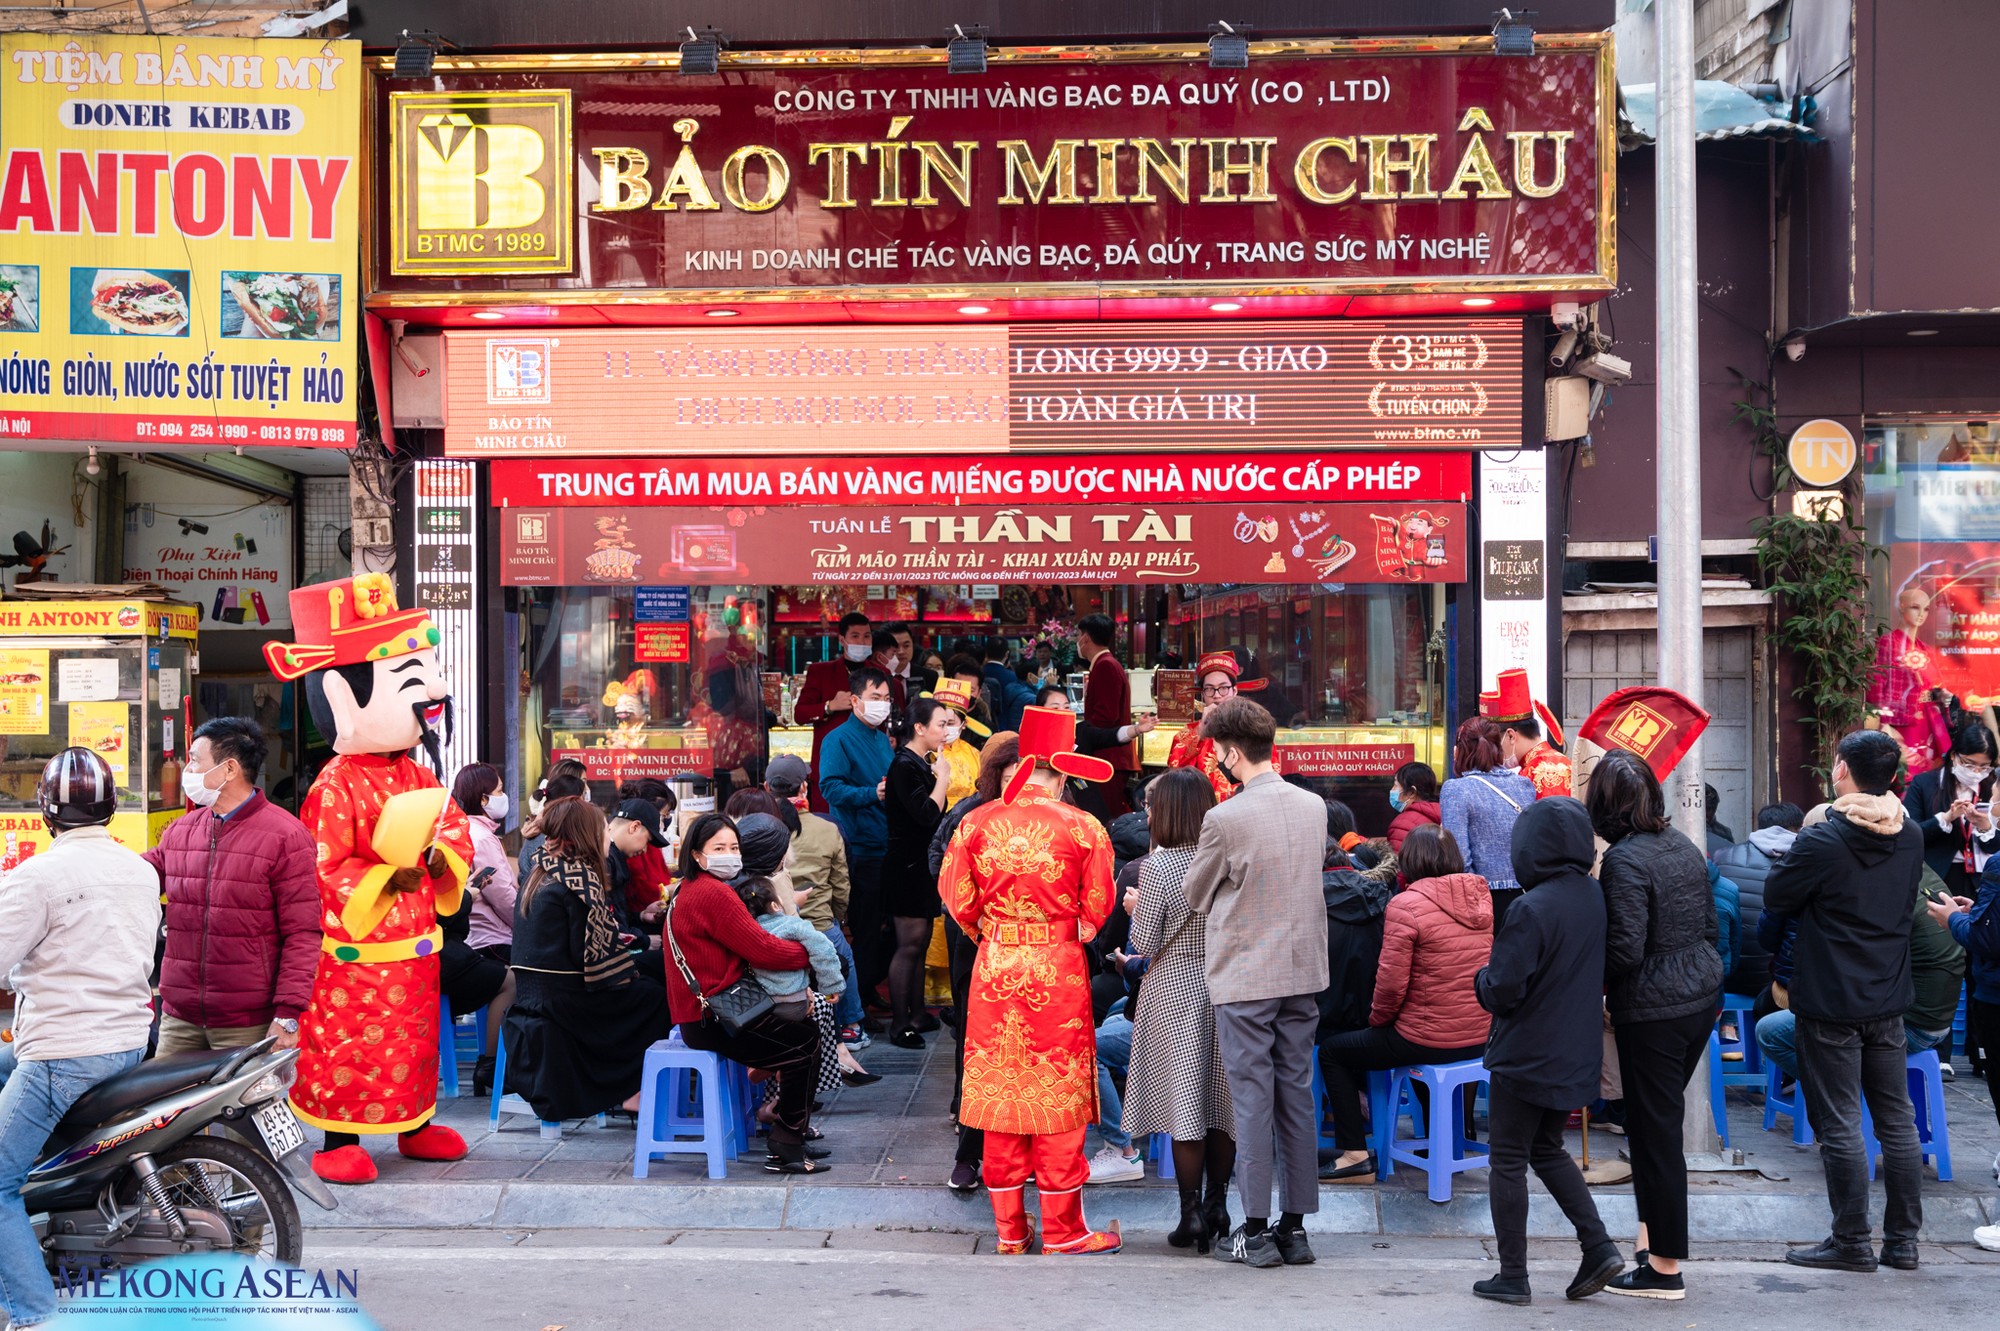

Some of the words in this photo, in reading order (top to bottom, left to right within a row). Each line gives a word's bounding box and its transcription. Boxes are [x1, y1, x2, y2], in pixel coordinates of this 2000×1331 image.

[13, 41, 123, 92] TIỆM
[135, 44, 264, 88] BÁNH
[773, 85, 855, 112] CÔNG
[860, 89, 897, 110] TY
[906, 87, 980, 110] TNHH
[985, 78, 1058, 109] VÀNG
[1064, 83, 1123, 111] BẠC
[1130, 82, 1173, 107] ĐA
[1179, 76, 1238, 107] QUÝ
[73, 103, 171, 127] DONER
[189, 106, 290, 130] KEBAB
[592, 118, 790, 213] BẢO
[808, 115, 979, 209] TÍN
[997, 137, 1278, 206] MINH
[1293, 106, 1574, 205] CHÂU
[0, 151, 348, 239] ANTONY
[417, 234, 485, 253] BTMC
[494, 233, 545, 252] 1989
[685, 250, 743, 271] KINH
[751, 249, 840, 270] DOANH
[846, 240, 899, 270] CHẾ
[907, 240, 956, 269] TÁC
[964, 238, 1031, 267] VÀNG
[1217, 241, 1305, 263] TRANG
[1315, 234, 1367, 262] SỨC
[1376, 235, 1414, 261] MỸ
[1420, 232, 1491, 266] NGHỆ
[1433, 335, 1466, 343] BTMC
[654, 342, 757, 377] VÀNG
[880, 341, 1005, 375] THĂNG
[1015, 347, 1117, 374] LONG
[1124, 346, 1209, 372] 999.9
[1238, 345, 1328, 372] GIAO
[64, 351, 117, 401] GIÒN,
[125, 357, 179, 398] NƯỚC
[187, 352, 225, 399] SỐT
[230, 359, 290, 409] TUYỆT
[304, 352, 344, 404] HẢO
[674, 397, 765, 429] DỊCH
[771, 397, 843, 428] MỌI
[932, 389, 1009, 423] BẢO
[1019, 387, 1117, 422] TOÀN
[1128, 388, 1189, 421] GIÁ
[1200, 393, 1257, 425] TRỊ
[1386, 393, 1429, 415] TUYỂN
[1432, 399, 1470, 417] CHỌN
[12, 417, 31, 436] NỘI
[488, 414, 522, 430] BẢO
[525, 413, 552, 430] TÍN
[137, 422, 156, 436] ĐT:
[159, 423, 183, 437] 094
[190, 424, 214, 438] 254
[218, 424, 247, 439] 1990
[260, 426, 291, 440] 0813
[295, 426, 318, 441] 979
[321, 427, 345, 442] 898
[475, 436, 517, 449] MINH
[521, 432, 567, 448] CHÂU
[1374, 427, 1481, 440] www.btmc.vn
[1797, 438, 1847, 468] TN
[538, 472, 633, 498] TRUNG
[639, 466, 700, 497] TÂM
[707, 471, 775, 497] MUA
[781, 465, 839, 496] BÁN
[844, 466, 923, 495] VÀNG
[931, 463, 1024, 494] MIẾNG
[1029, 468, 1115, 498] ĐƯỢC
[1122, 463, 1185, 493] NHÀ
[1193, 463, 1275, 493] NƯỚC
[1282, 458, 1340, 492] CẤP
[1347, 463, 1421, 491] PHÉP
[809, 517, 864, 533] TUẦN
[870, 516, 891, 533] LỄ
[899, 509, 1072, 543] THẦN
[1092, 509, 1193, 542] TÀI
[157, 547, 195, 563] Phụ
[200, 547, 242, 563] Kiện
[533, 556, 556, 564] CHÂU
[813, 549, 851, 568] KIM
[857, 550, 897, 568] MÃO
[903, 547, 950, 567] THẦN
[956, 550, 984, 567] TÀI
[1002, 553, 1047, 567] KHAI
[1052, 549, 1102, 567] XUÂN
[1108, 553, 1139, 570] ĐẠI
[1144, 549, 1196, 569] PHÁT
[156, 568, 193, 583] Thoại
[198, 567, 238, 581] Chính
[242, 567, 278, 583] Hãng
[825, 571, 850, 580] NGÀY
[1032, 571, 1080, 580] 10/01/2023
[27, 612, 113, 626] ANTONY
[176, 613, 197, 631] KEBAB
[1614, 731, 1629, 743] BTMC
[588, 753, 612, 765] BẢO
[637, 755, 668, 764] MINH
[671, 753, 704, 764] CHÂU
[1287, 750, 1311, 760] BẢO
[1315, 749, 1334, 760] TÍN
[1337, 750, 1369, 760] MINH
[1372, 748, 1405, 760] CHÂU
[647, 768, 669, 776] NHÂN
[1298, 763, 1318, 772] KÍNH
[1320, 763, 1344, 772] CHÀO
[1346, 762, 1363, 772] QUÝ
[1365, 762, 1394, 771] KHÁCH
[268, 1122, 303, 1154] 567.37
